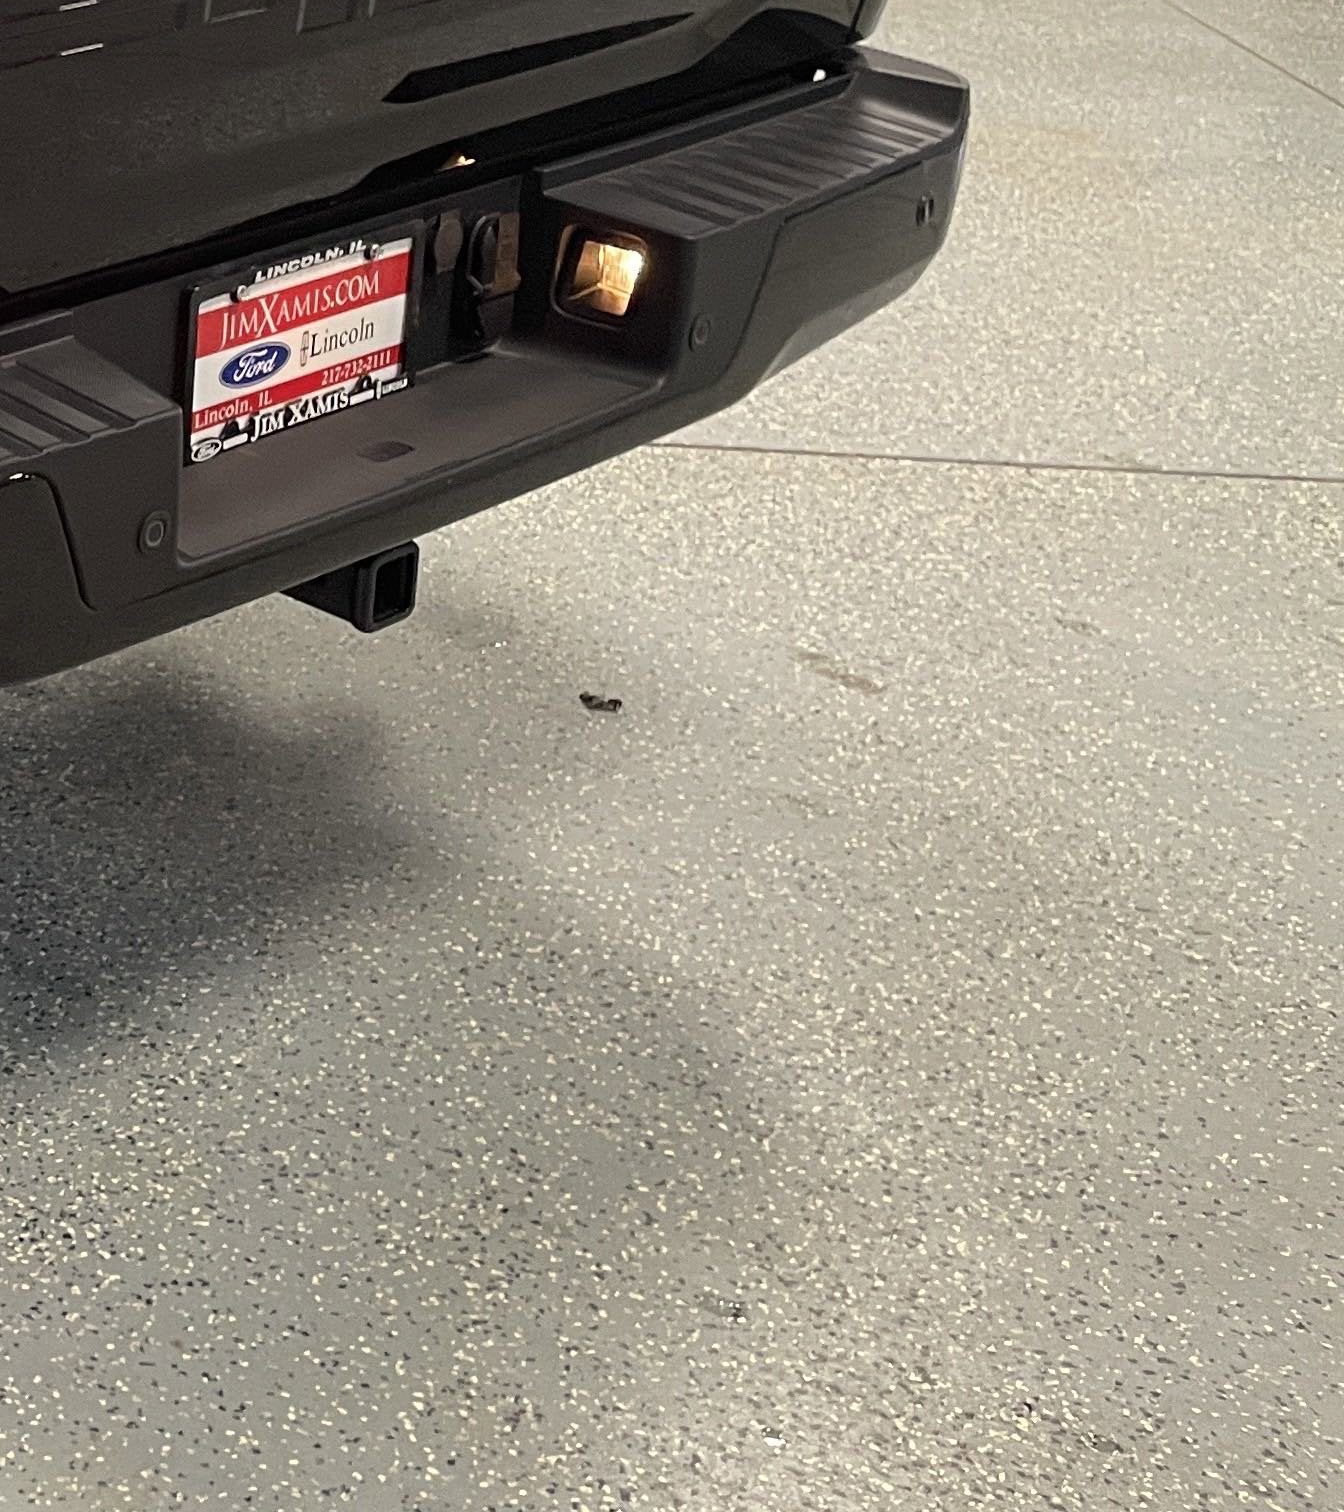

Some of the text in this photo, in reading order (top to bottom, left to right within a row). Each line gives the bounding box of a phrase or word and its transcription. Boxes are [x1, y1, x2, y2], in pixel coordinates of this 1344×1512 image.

[349, 239, 367, 255] IL
[220, 270, 380, 350] JIMXAMIS.COM
[310, 317, 374, 358] Lincoln
[233, 348, 278, 382] Ford
[194, 390, 273, 429] Lincoln, IL
[250, 391, 349, 442] JIM XAMIS
